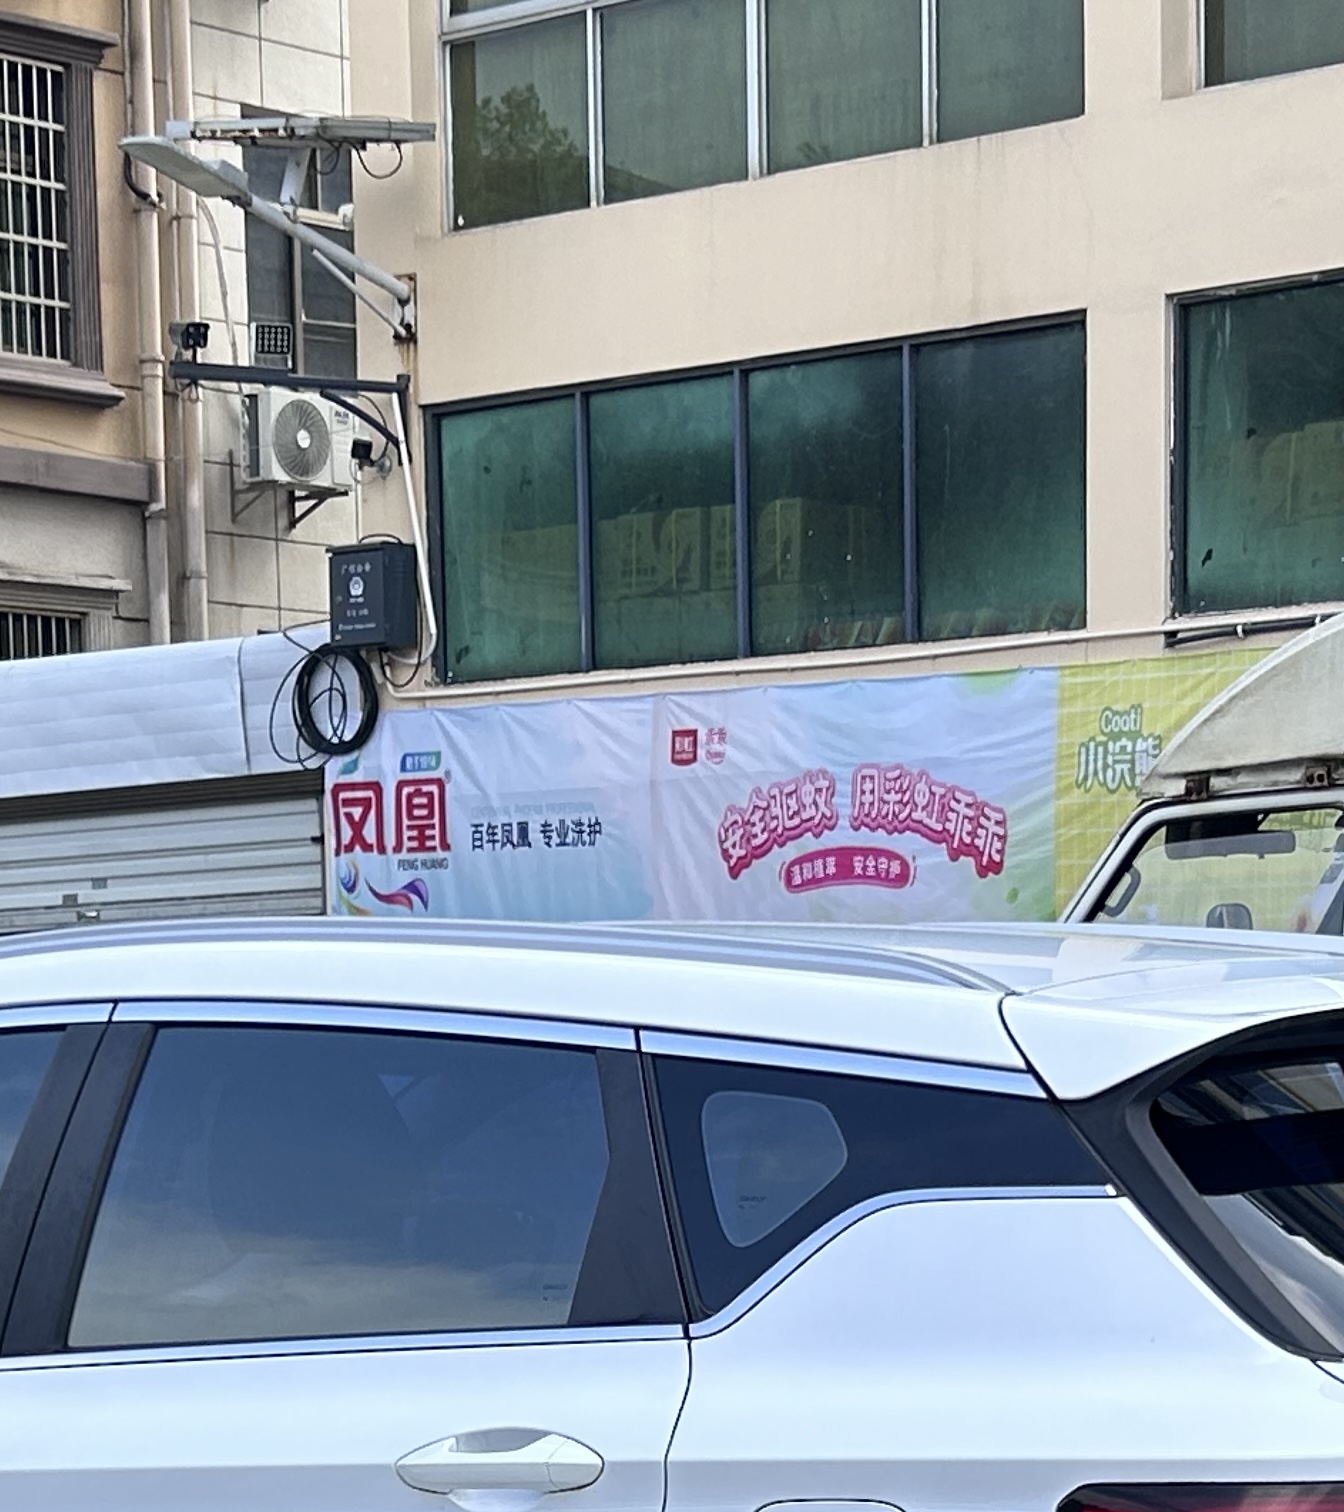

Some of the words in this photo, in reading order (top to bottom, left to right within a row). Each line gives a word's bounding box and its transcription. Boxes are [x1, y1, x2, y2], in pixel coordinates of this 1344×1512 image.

[330, 777, 451, 858] 凤凰
[470, 821, 533, 852] 百年凤凰
[539, 816, 603, 849] 专业洗护
[719, 770, 836, 872] 安全驱蚊
[852, 766, 1006, 868] 用彩虹乖乖
